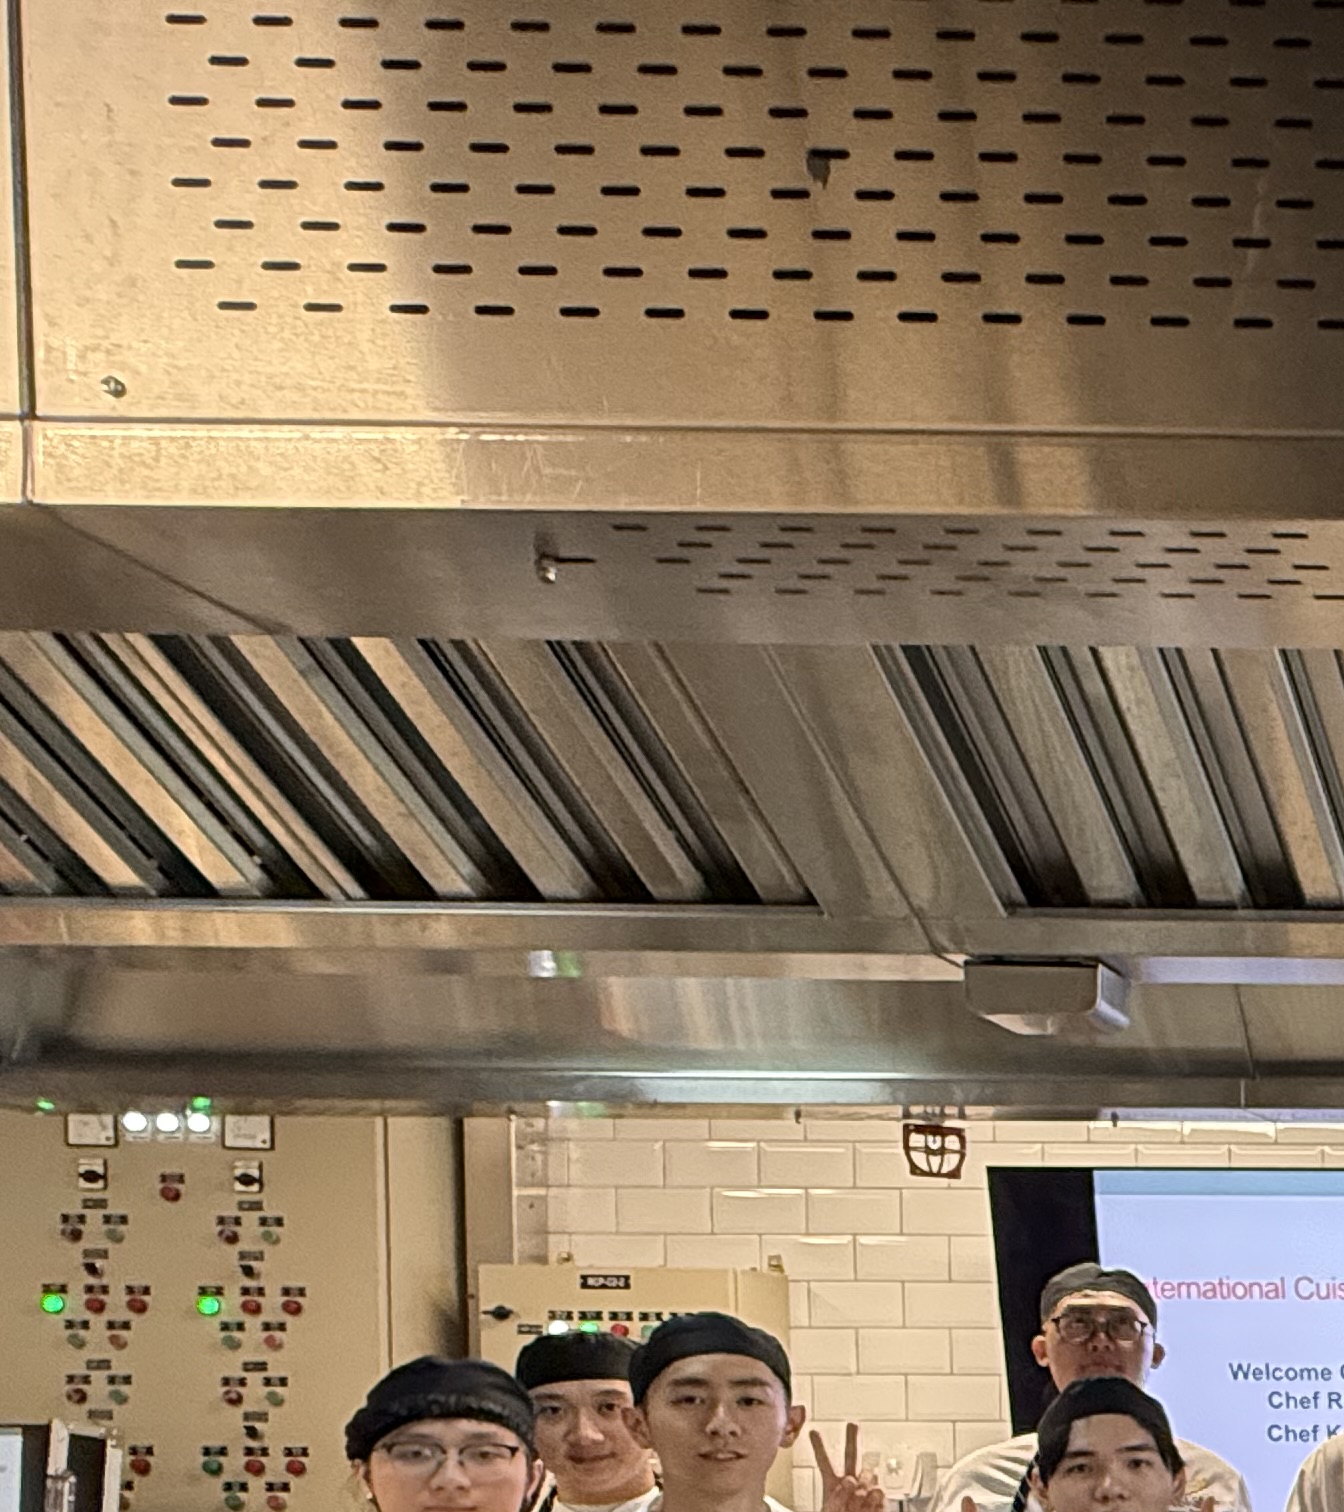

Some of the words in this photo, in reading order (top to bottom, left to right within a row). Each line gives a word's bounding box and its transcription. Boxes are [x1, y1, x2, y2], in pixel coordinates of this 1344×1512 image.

[1152, 1275, 1286, 1300] ternational
[1228, 1362, 1332, 1382] Welcome
[1267, 1391, 1320, 1410] Chef
[1266, 1424, 1320, 1443] Chef
